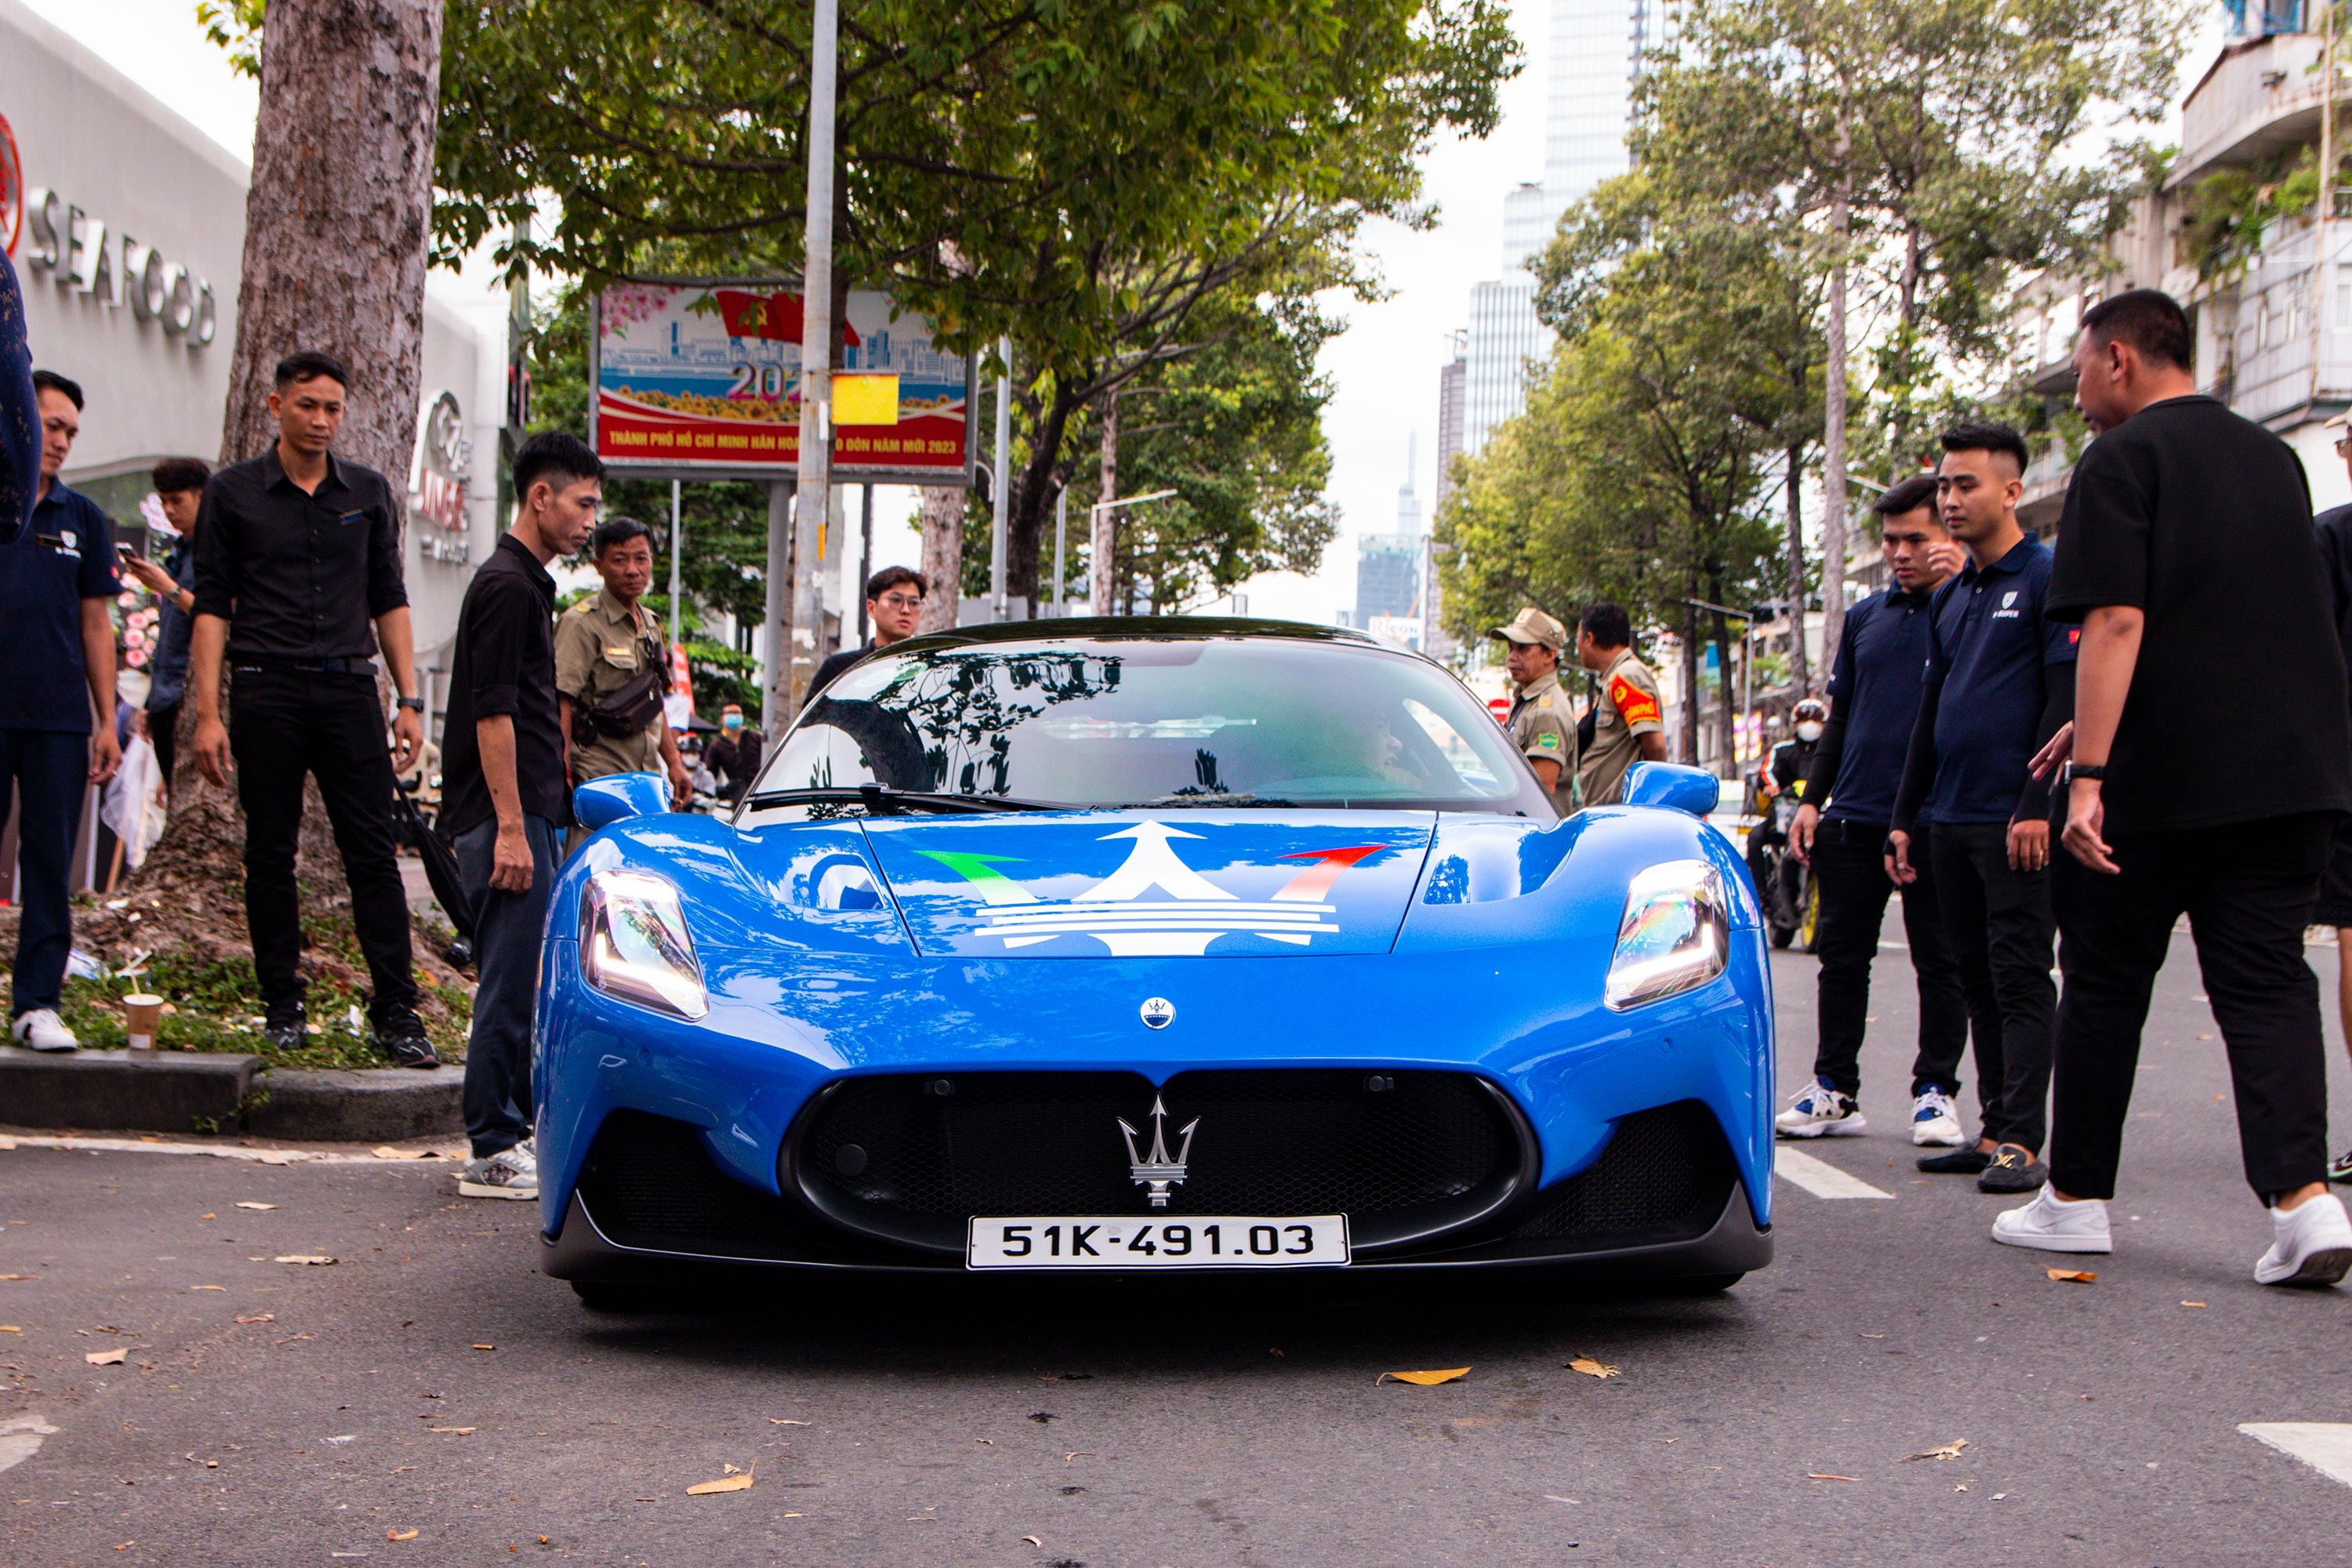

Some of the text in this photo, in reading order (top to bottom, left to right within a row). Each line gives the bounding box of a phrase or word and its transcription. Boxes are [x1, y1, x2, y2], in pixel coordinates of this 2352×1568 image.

[27, 187, 216, 347] SEAFOOD
[609, 430, 648, 446] THÀNH
[650, 430, 674, 448] PHỐ
[695, 432, 715, 448] CHÍ
[717, 434, 749, 449] MINH
[873, 437, 901, 453] NĂM
[902, 437, 926, 453] MỚI
[927, 439, 957, 454] 2023
[1002, 1225, 1314, 1258] 51K-491.03
